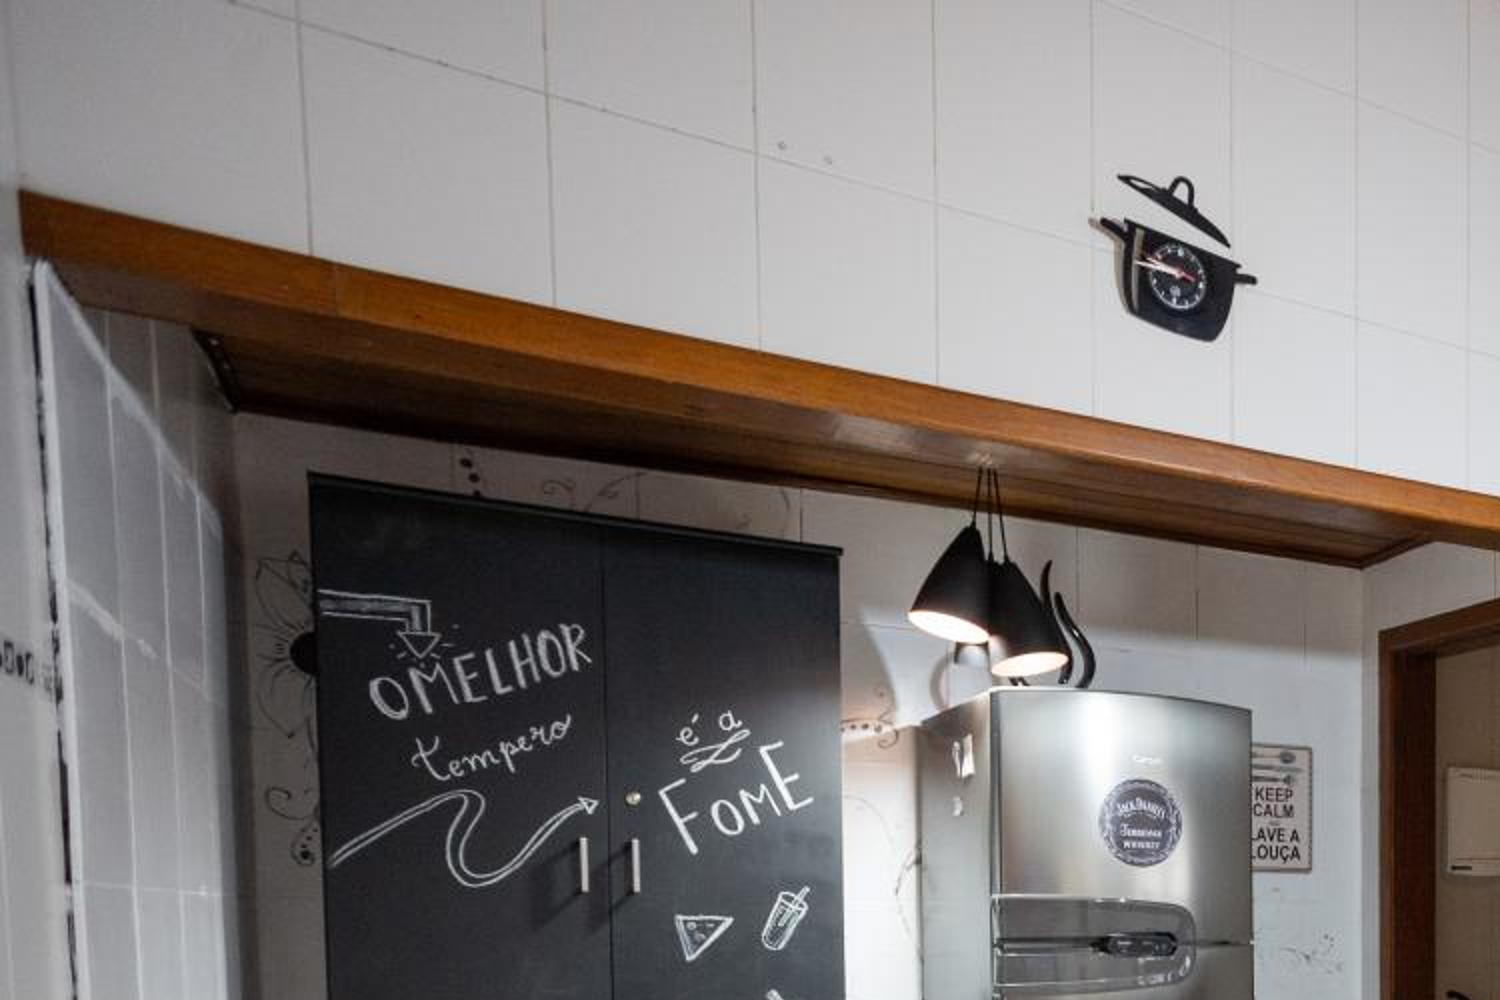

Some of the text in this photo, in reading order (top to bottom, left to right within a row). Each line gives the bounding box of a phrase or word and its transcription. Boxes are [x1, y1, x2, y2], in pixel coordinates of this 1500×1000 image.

[411, 714, 571, 781] tempero
[658, 741, 814, 855] FOME
[1254, 786, 1294, 803] KEEP
[1253, 803, 1295, 818] CALM
[1289, 828, 1301, 843] A
